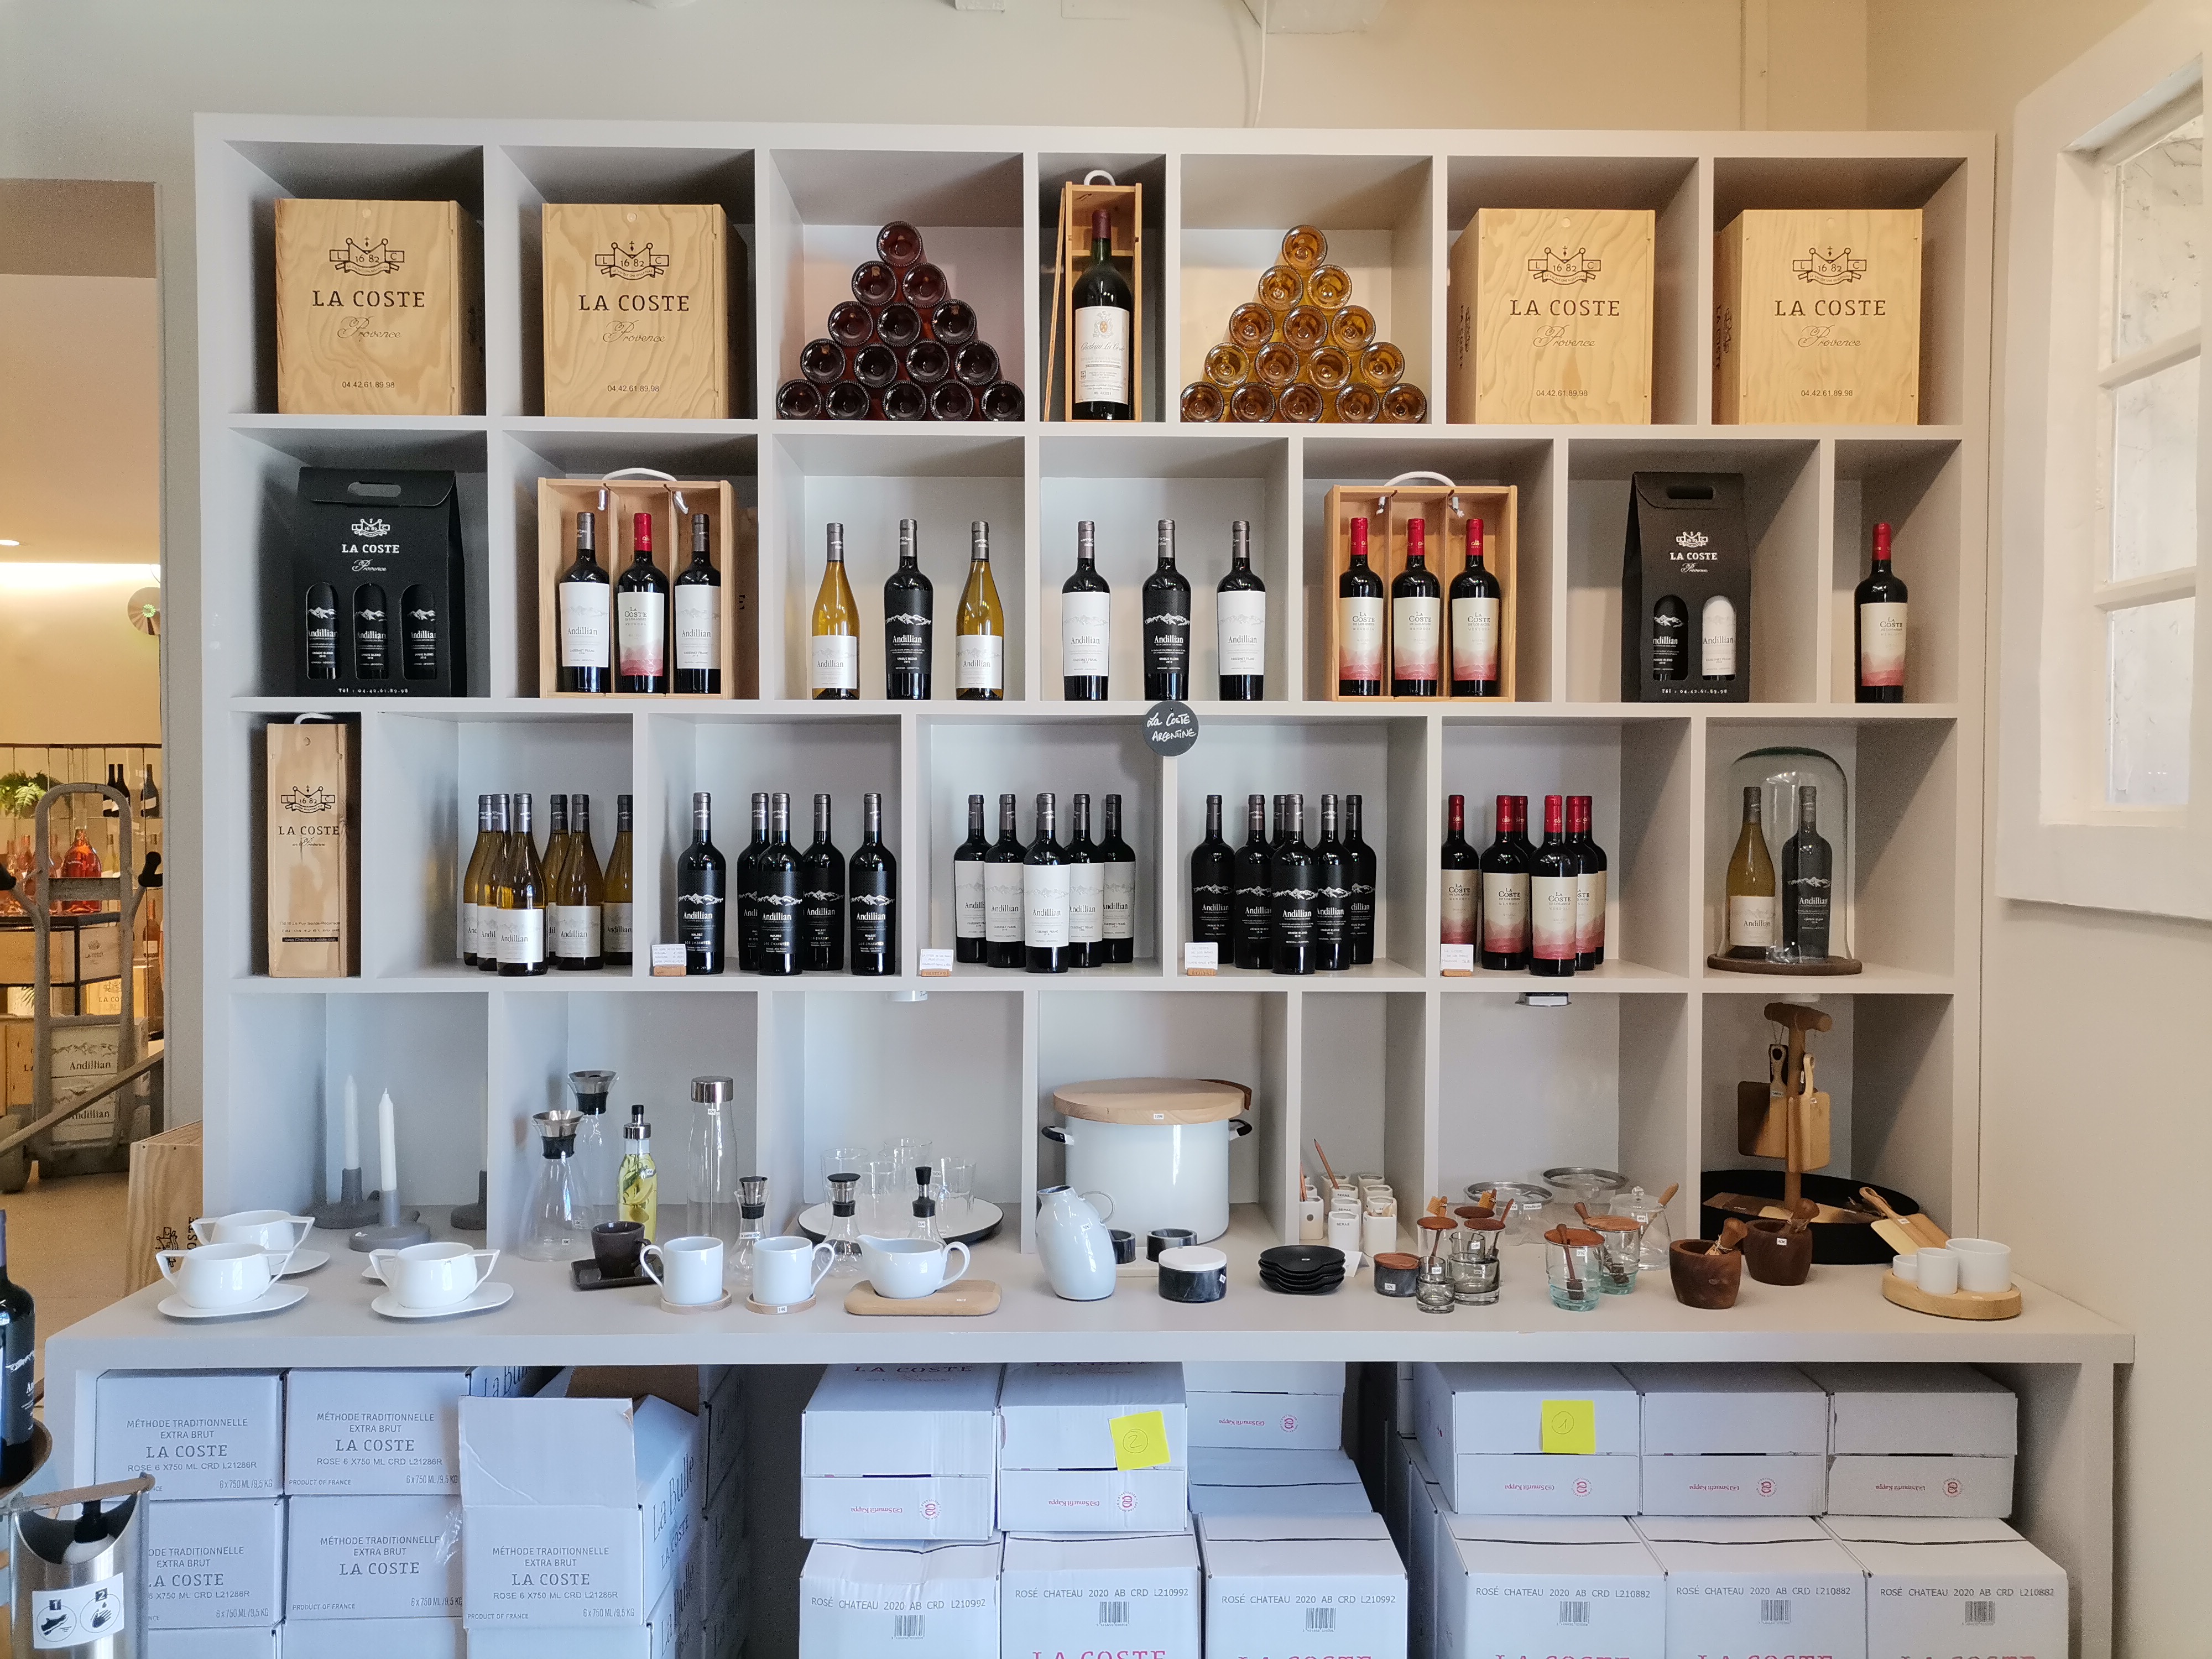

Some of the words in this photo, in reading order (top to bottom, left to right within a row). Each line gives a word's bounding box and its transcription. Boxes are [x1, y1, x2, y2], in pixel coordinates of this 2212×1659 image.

[312, 290, 345, 306] LA
[353, 290, 425, 307] COSTE
[578, 295, 610, 311] LA
[618, 295, 689, 311] COSTE
[1510, 300, 1541, 316] LA
[1550, 300, 1620, 316] COSTE
[1775, 300, 1806, 316] LA
[1814, 300, 1885, 316] COSTE
[337, 316, 400, 338] Provence
[603, 320, 665, 343] Provence
[1533, 325, 1595, 348] Provence
[1798, 325, 1861, 348] Provence
[342, 544, 358, 553] LA
[362, 544, 400, 554] COSTE
[352, 559, 387, 571] Provence
[567, 627, 598, 635] Andillian
[681, 629, 711, 638] Andillian
[892, 635, 922, 643] Andillian
[1071, 636, 1100, 644] Andillian
[1154, 635, 1183, 643] Andillian
[1653, 636, 1678, 644] ndillian
[1703, 636, 1734, 645] Andillian
[278, 826, 296, 835] LA
[300, 826, 339, 835] COSTE
[683, 911, 713, 920] Andillian
[762, 912, 791, 920] Andillian
[856, 912, 885, 920] Andillian
[1032, 908, 1061, 916] Andillian
[1282, 910, 1312, 918] Andillian
[69, 1060, 111, 1070] Andillian
[317, 1411, 359, 1421] MÉTHODE
[361, 1413, 435, 1421] TRADITIONNELLE
[127, 1417, 170, 1428] MÉTHODE
[173, 1418, 248, 1427] TRADITIONNELLE
[335, 1439, 358, 1452] LA
[364, 1439, 415, 1452] COSTE
[1128, 1435, 1142, 1449] 2
[146, 1446, 169, 1458] LA
[175, 1444, 227, 1457] COSTE
[653, 1500, 667, 1543] La
[669, 1452, 694, 1517] Bulle
[320, 1536, 364, 1545] MÉTHODE
[169, 1546, 244, 1556] TRADITIONNELLE
[353, 1548, 381, 1556] EXTRA
[384, 1547, 407, 1556] BRUT
[492, 1546, 534, 1556] MÉTHODE
[157, 1559, 185, 1568] EXTRA
[187, 1558, 211, 1567] BRUT
[339, 1563, 363, 1575] LA
[368, 1562, 420, 1574] COSTE
[172, 1573, 224, 1587] COSTE
[511, 1573, 535, 1586] LA
[540, 1573, 590, 1585] COSTE
[98, 1590, 105, 1600] 2
[1476, 1586, 1499, 1596] ROSÉ
[1504, 1588, 1544, 1597] CHATEAU
[1549, 1589, 1569, 1597] 2020
[1592, 1589, 1610, 1598] CRD
[1615, 1589, 1651, 1598] L210882
[1880, 1586, 1903, 1597] ROSÉ
[1908, 1588, 1948, 1597] CHATEAU
[1953, 1588, 1974, 1597] 2020
[1979, 1588, 1991, 1597] AB
[1996, 1588, 2014, 1597] CRD
[2020, 1588, 2054, 1597] L210882
[811, 1597, 833, 1608] ROSÉ
[838, 1599, 879, 1610] CHATEAU
[884, 1601, 905, 1610] 2020
[909, 1601, 922, 1610] AB
[927, 1600, 945, 1610] CRD
[951, 1599, 986, 1609] L210992
[1222, 1594, 1245, 1604] ROSÉ
[1250, 1595, 1291, 1604] CHATEAU
[1295, 1595, 1316, 1604] 2020
[1321, 1595, 1333, 1604] AB
[1338, 1595, 1356, 1604] CRD
[1361, 1595, 1396, 1604] L210992
